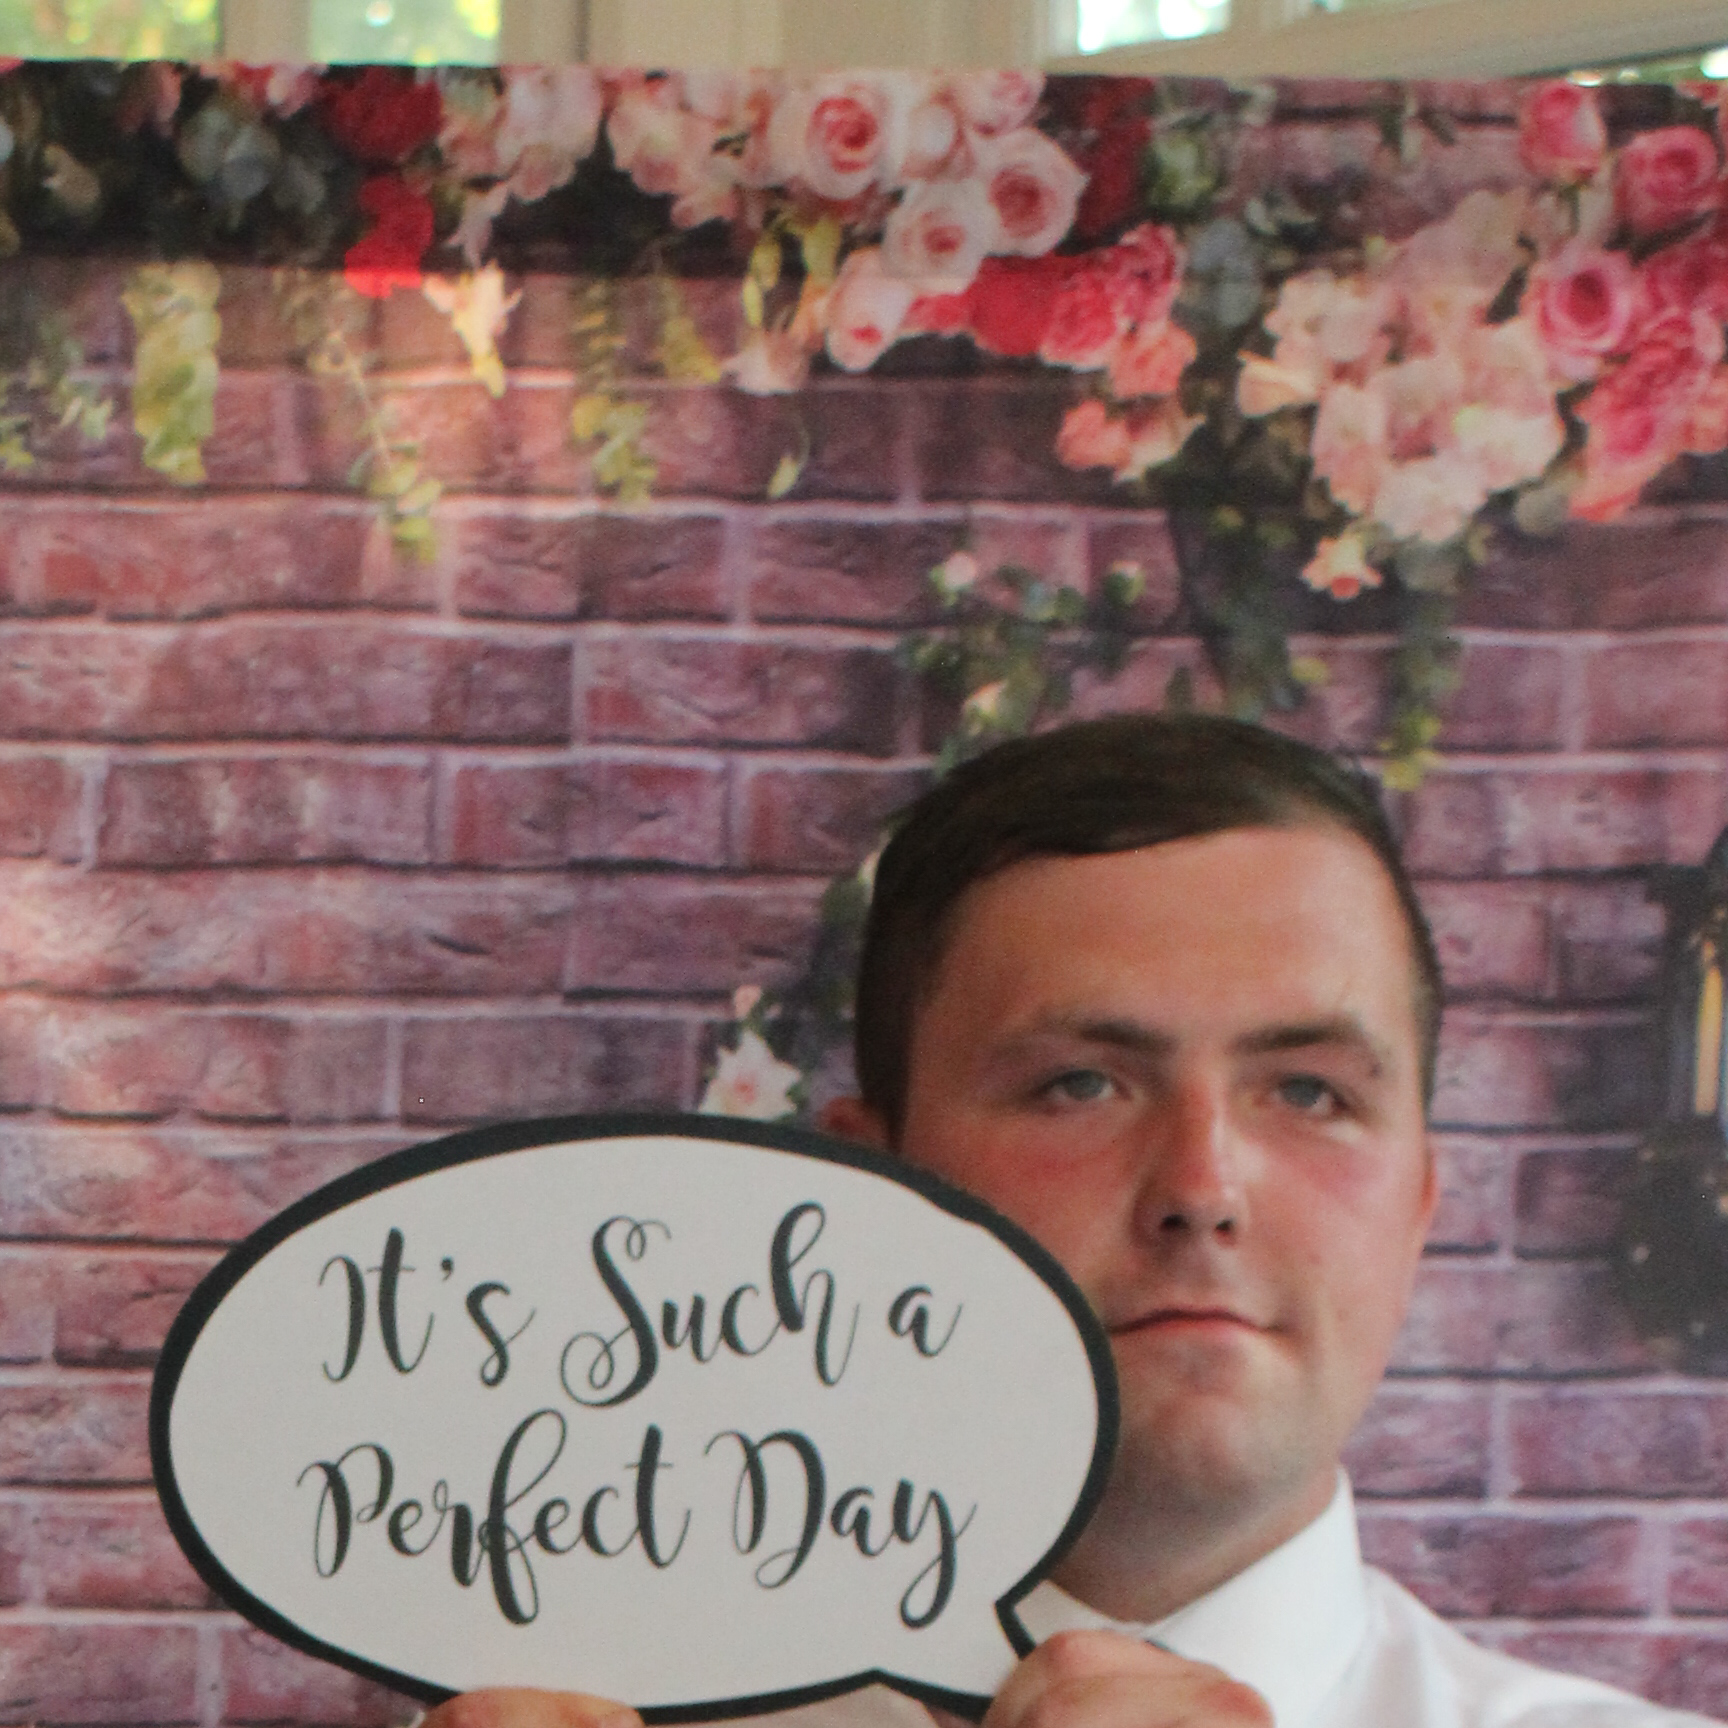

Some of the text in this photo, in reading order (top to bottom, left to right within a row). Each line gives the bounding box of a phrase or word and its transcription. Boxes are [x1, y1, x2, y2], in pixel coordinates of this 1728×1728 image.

[317, 1202, 964, 1408] It's Such a
[296, 1409, 976, 1630] Perfect Day
